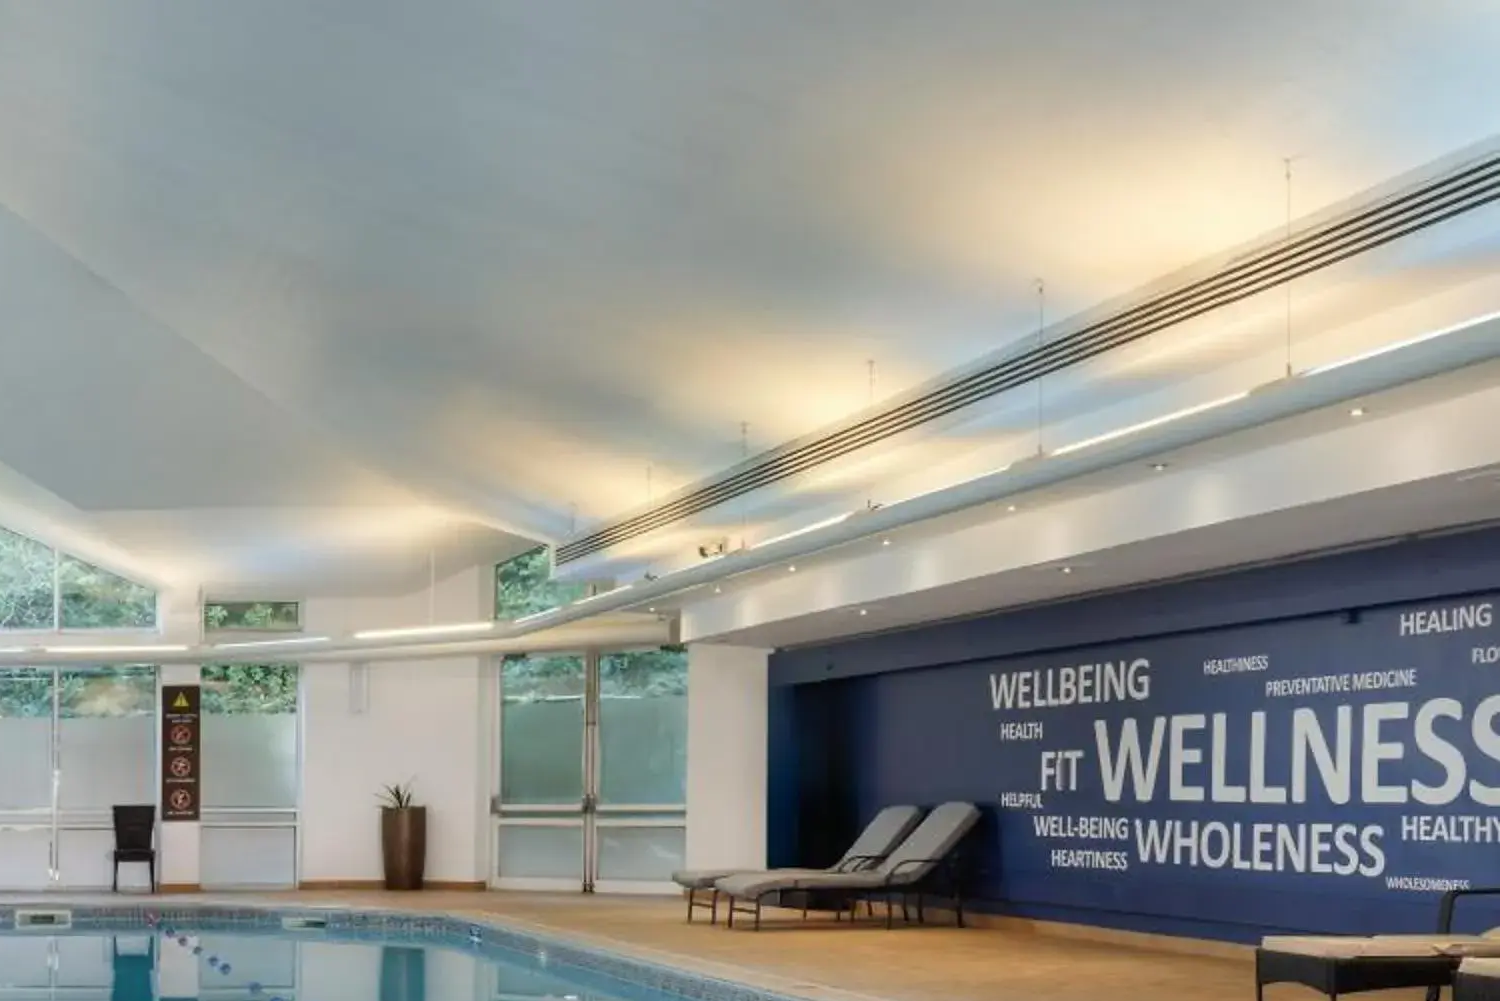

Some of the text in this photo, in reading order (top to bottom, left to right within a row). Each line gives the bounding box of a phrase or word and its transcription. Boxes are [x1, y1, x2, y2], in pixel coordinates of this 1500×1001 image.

[1399, 603, 1493, 636] HEALING
[1203, 655, 1269, 676] HEALTHINESS
[1471, 646, 1500, 664] FLO
[989, 658, 1150, 710] WELLBEING
[1265, 668, 1417, 698] PREVENTATIVE MEDICINE
[1000, 722, 1043, 740] HEALTH
[1041, 694, 1500, 807] FIT WELLNESS
[1001, 791, 1043, 809] HELPFUL
[1033, 814, 1129, 840] WELL-BEING
[1134, 819, 1385, 877] WHOLENESS
[1051, 849, 1128, 871] HEARTINESS
